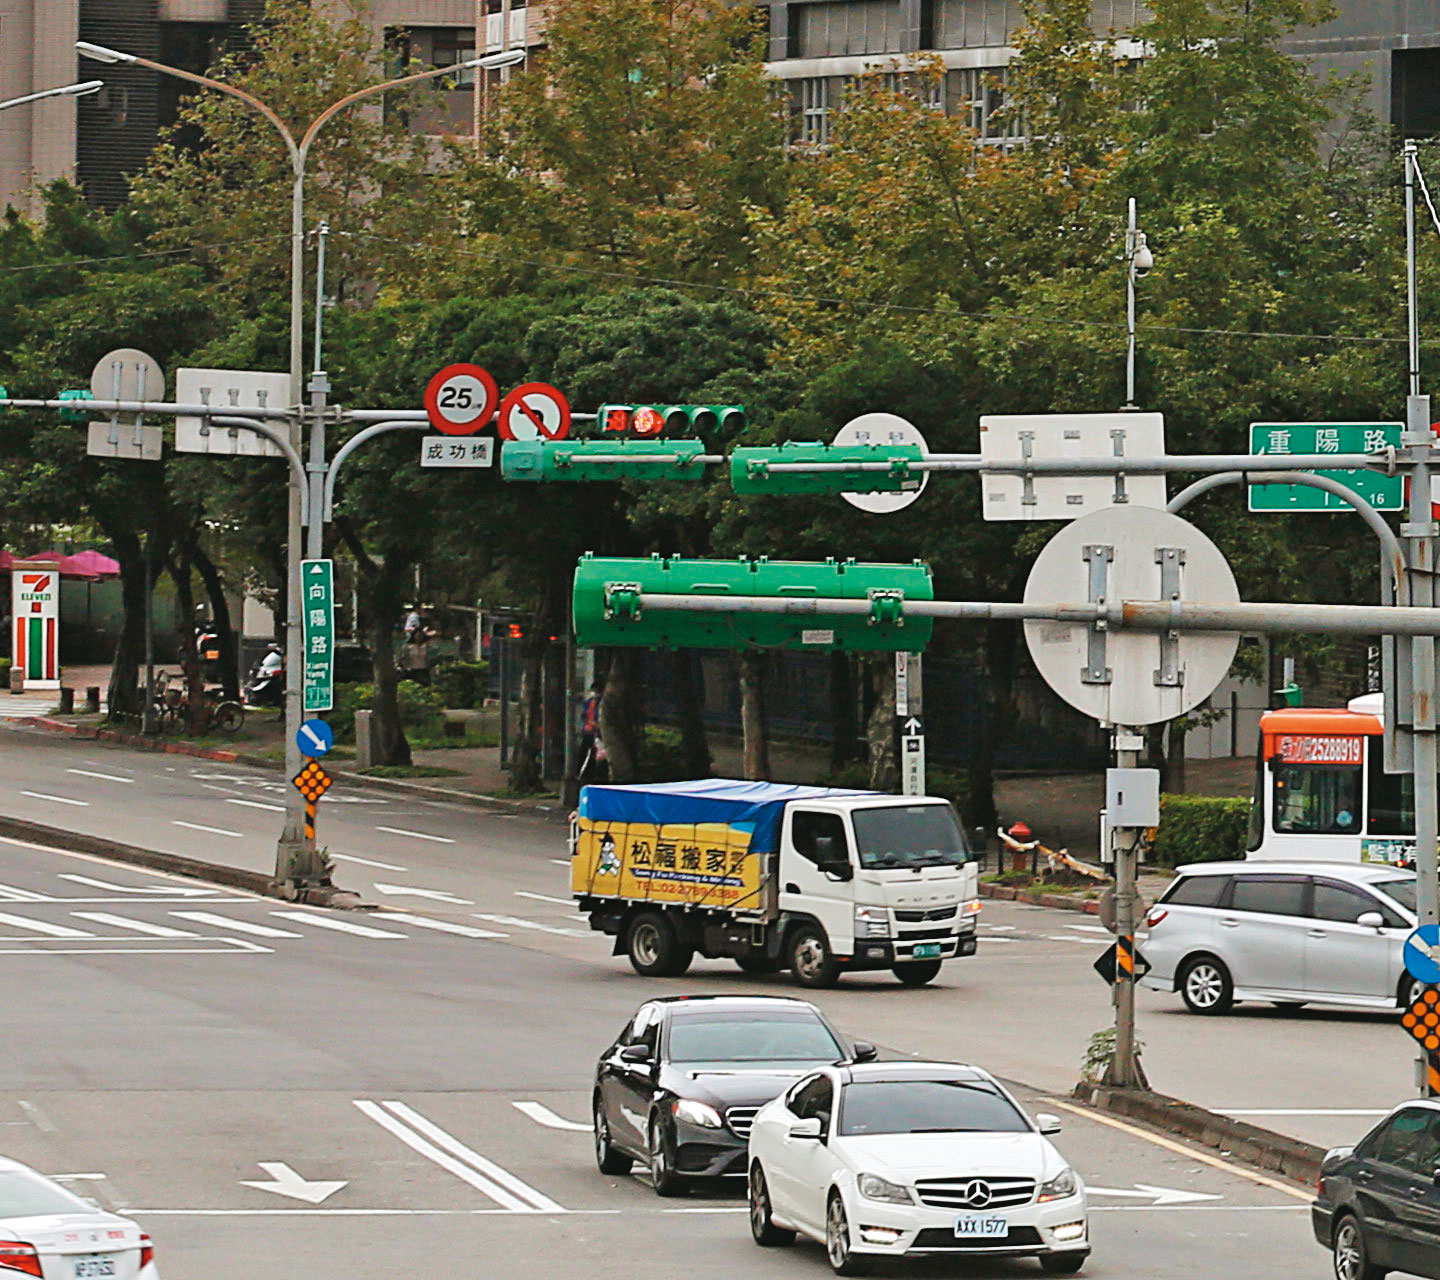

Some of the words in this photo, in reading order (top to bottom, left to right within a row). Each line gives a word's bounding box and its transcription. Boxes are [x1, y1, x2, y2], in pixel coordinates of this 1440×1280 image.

[440, 387, 472, 409] 25
[427, 444, 488, 460] 成功橋
[1268, 429, 1388, 455] 重陽路
[310, 583, 327, 654] 向陽路
